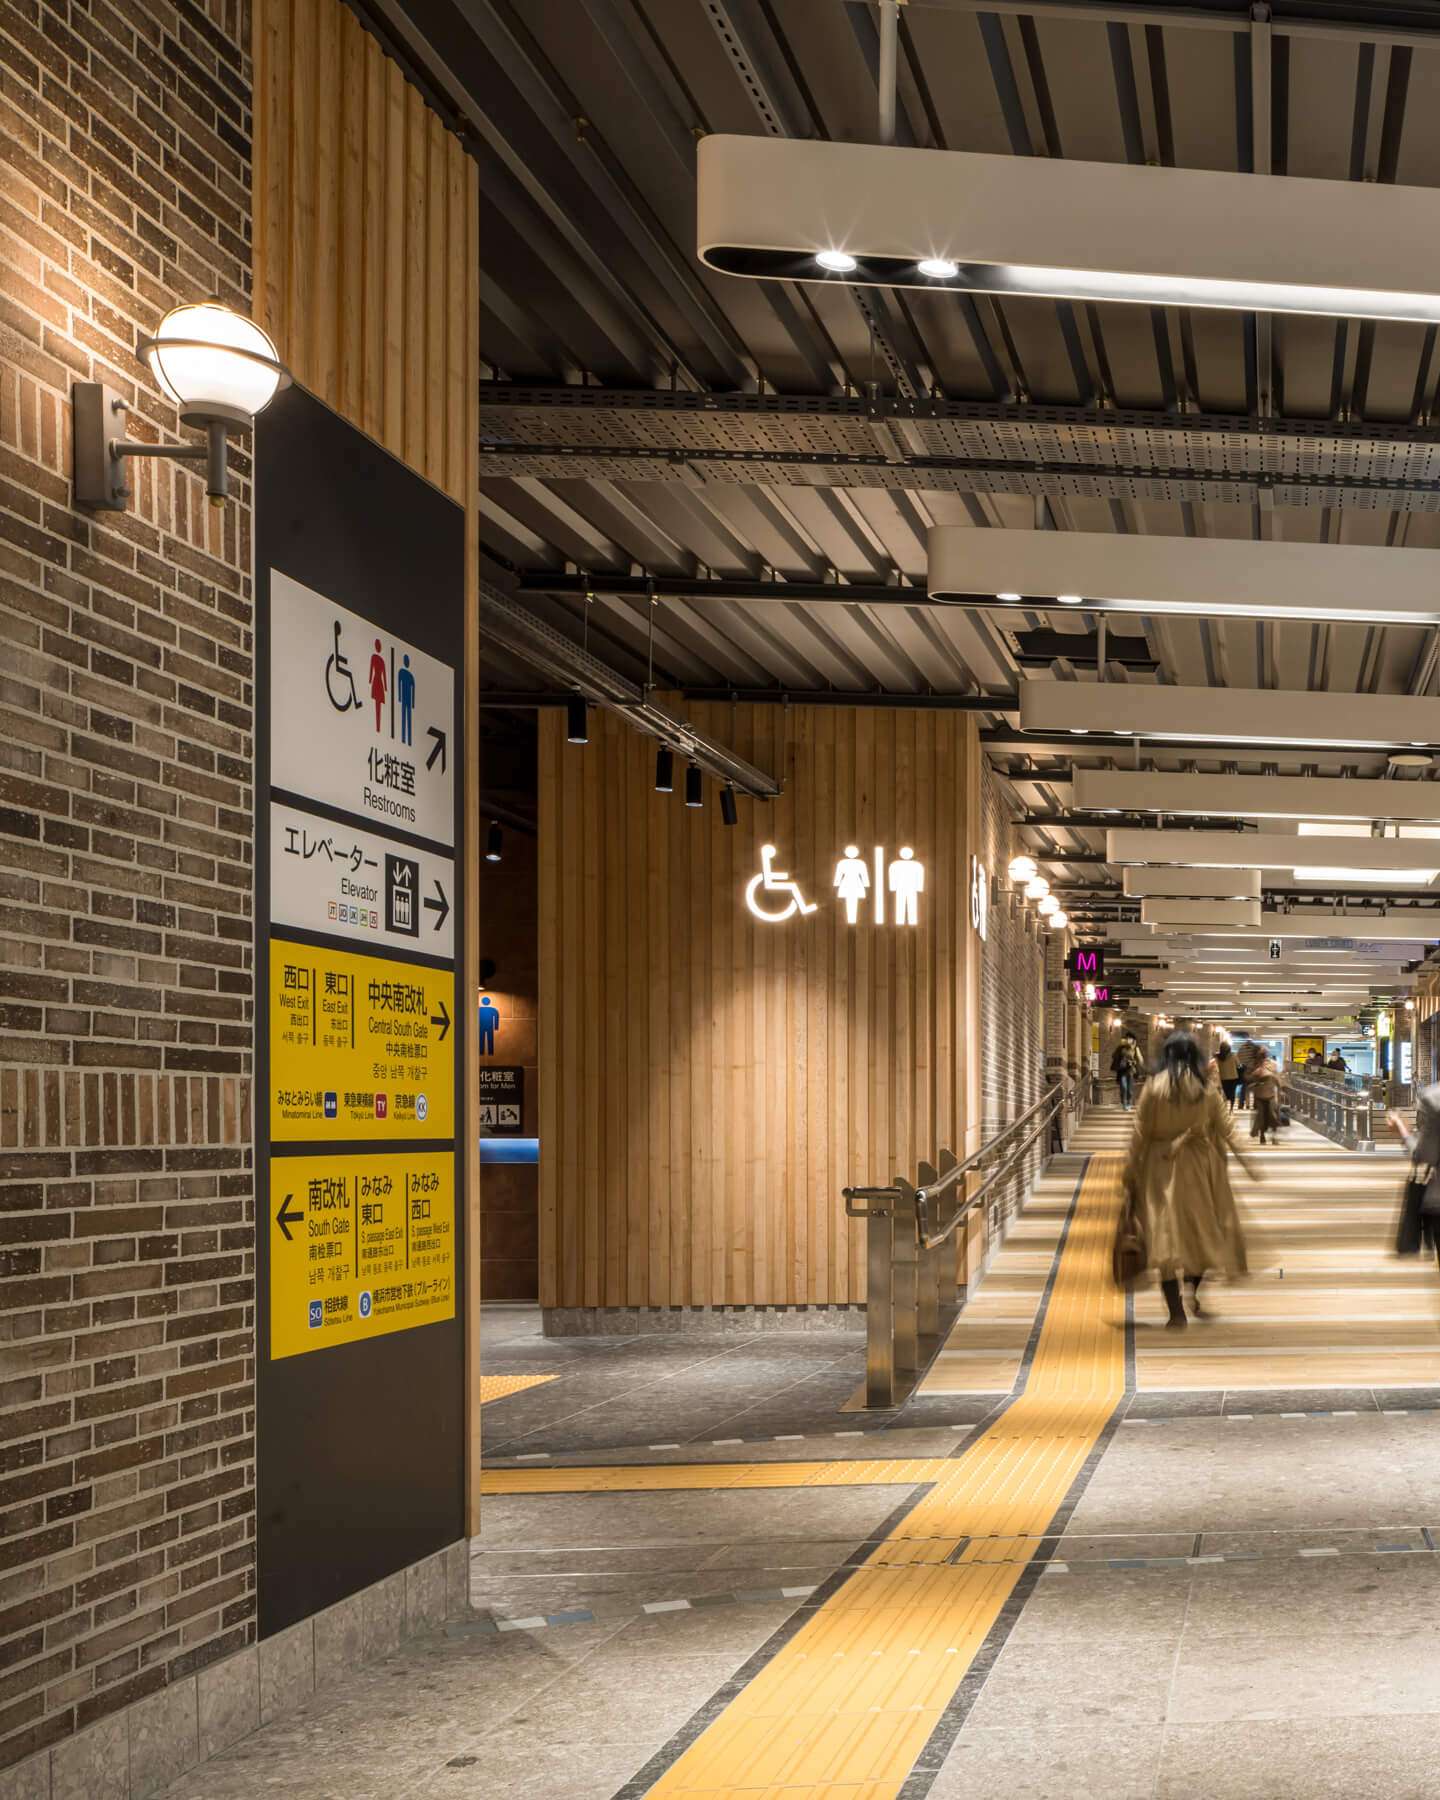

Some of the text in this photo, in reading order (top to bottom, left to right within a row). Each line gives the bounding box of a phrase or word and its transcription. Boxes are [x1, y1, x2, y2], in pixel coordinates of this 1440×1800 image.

[368, 747, 416, 796] 化粧室
[364, 787, 416, 823] Restrooms
[284, 827, 379, 872] エレベーター
[341, 878, 379, 902] Elevator
[1078, 952, 1096, 970] M
[284, 965, 309, 992] 西口
[325, 972, 348, 996] 東口
[279, 994, 309, 1010] West Exit
[368, 979, 428, 1016] 中央南改札
[1095, 988, 1108, 1001] M
[323, 999, 348, 1014] East Exit
[368, 1016, 428, 1039] Central South Gate
[480, 1071, 514, 1082] 化粧室
[361, 1175, 393, 1197] みなみ
[411, 1172, 440, 1193] みなみ
[308, 1177, 350, 1212] 南改札
[361, 1203, 383, 1226] 東口
[411, 1199, 431, 1221] 西口
[308, 1216, 350, 1238] South Gate
